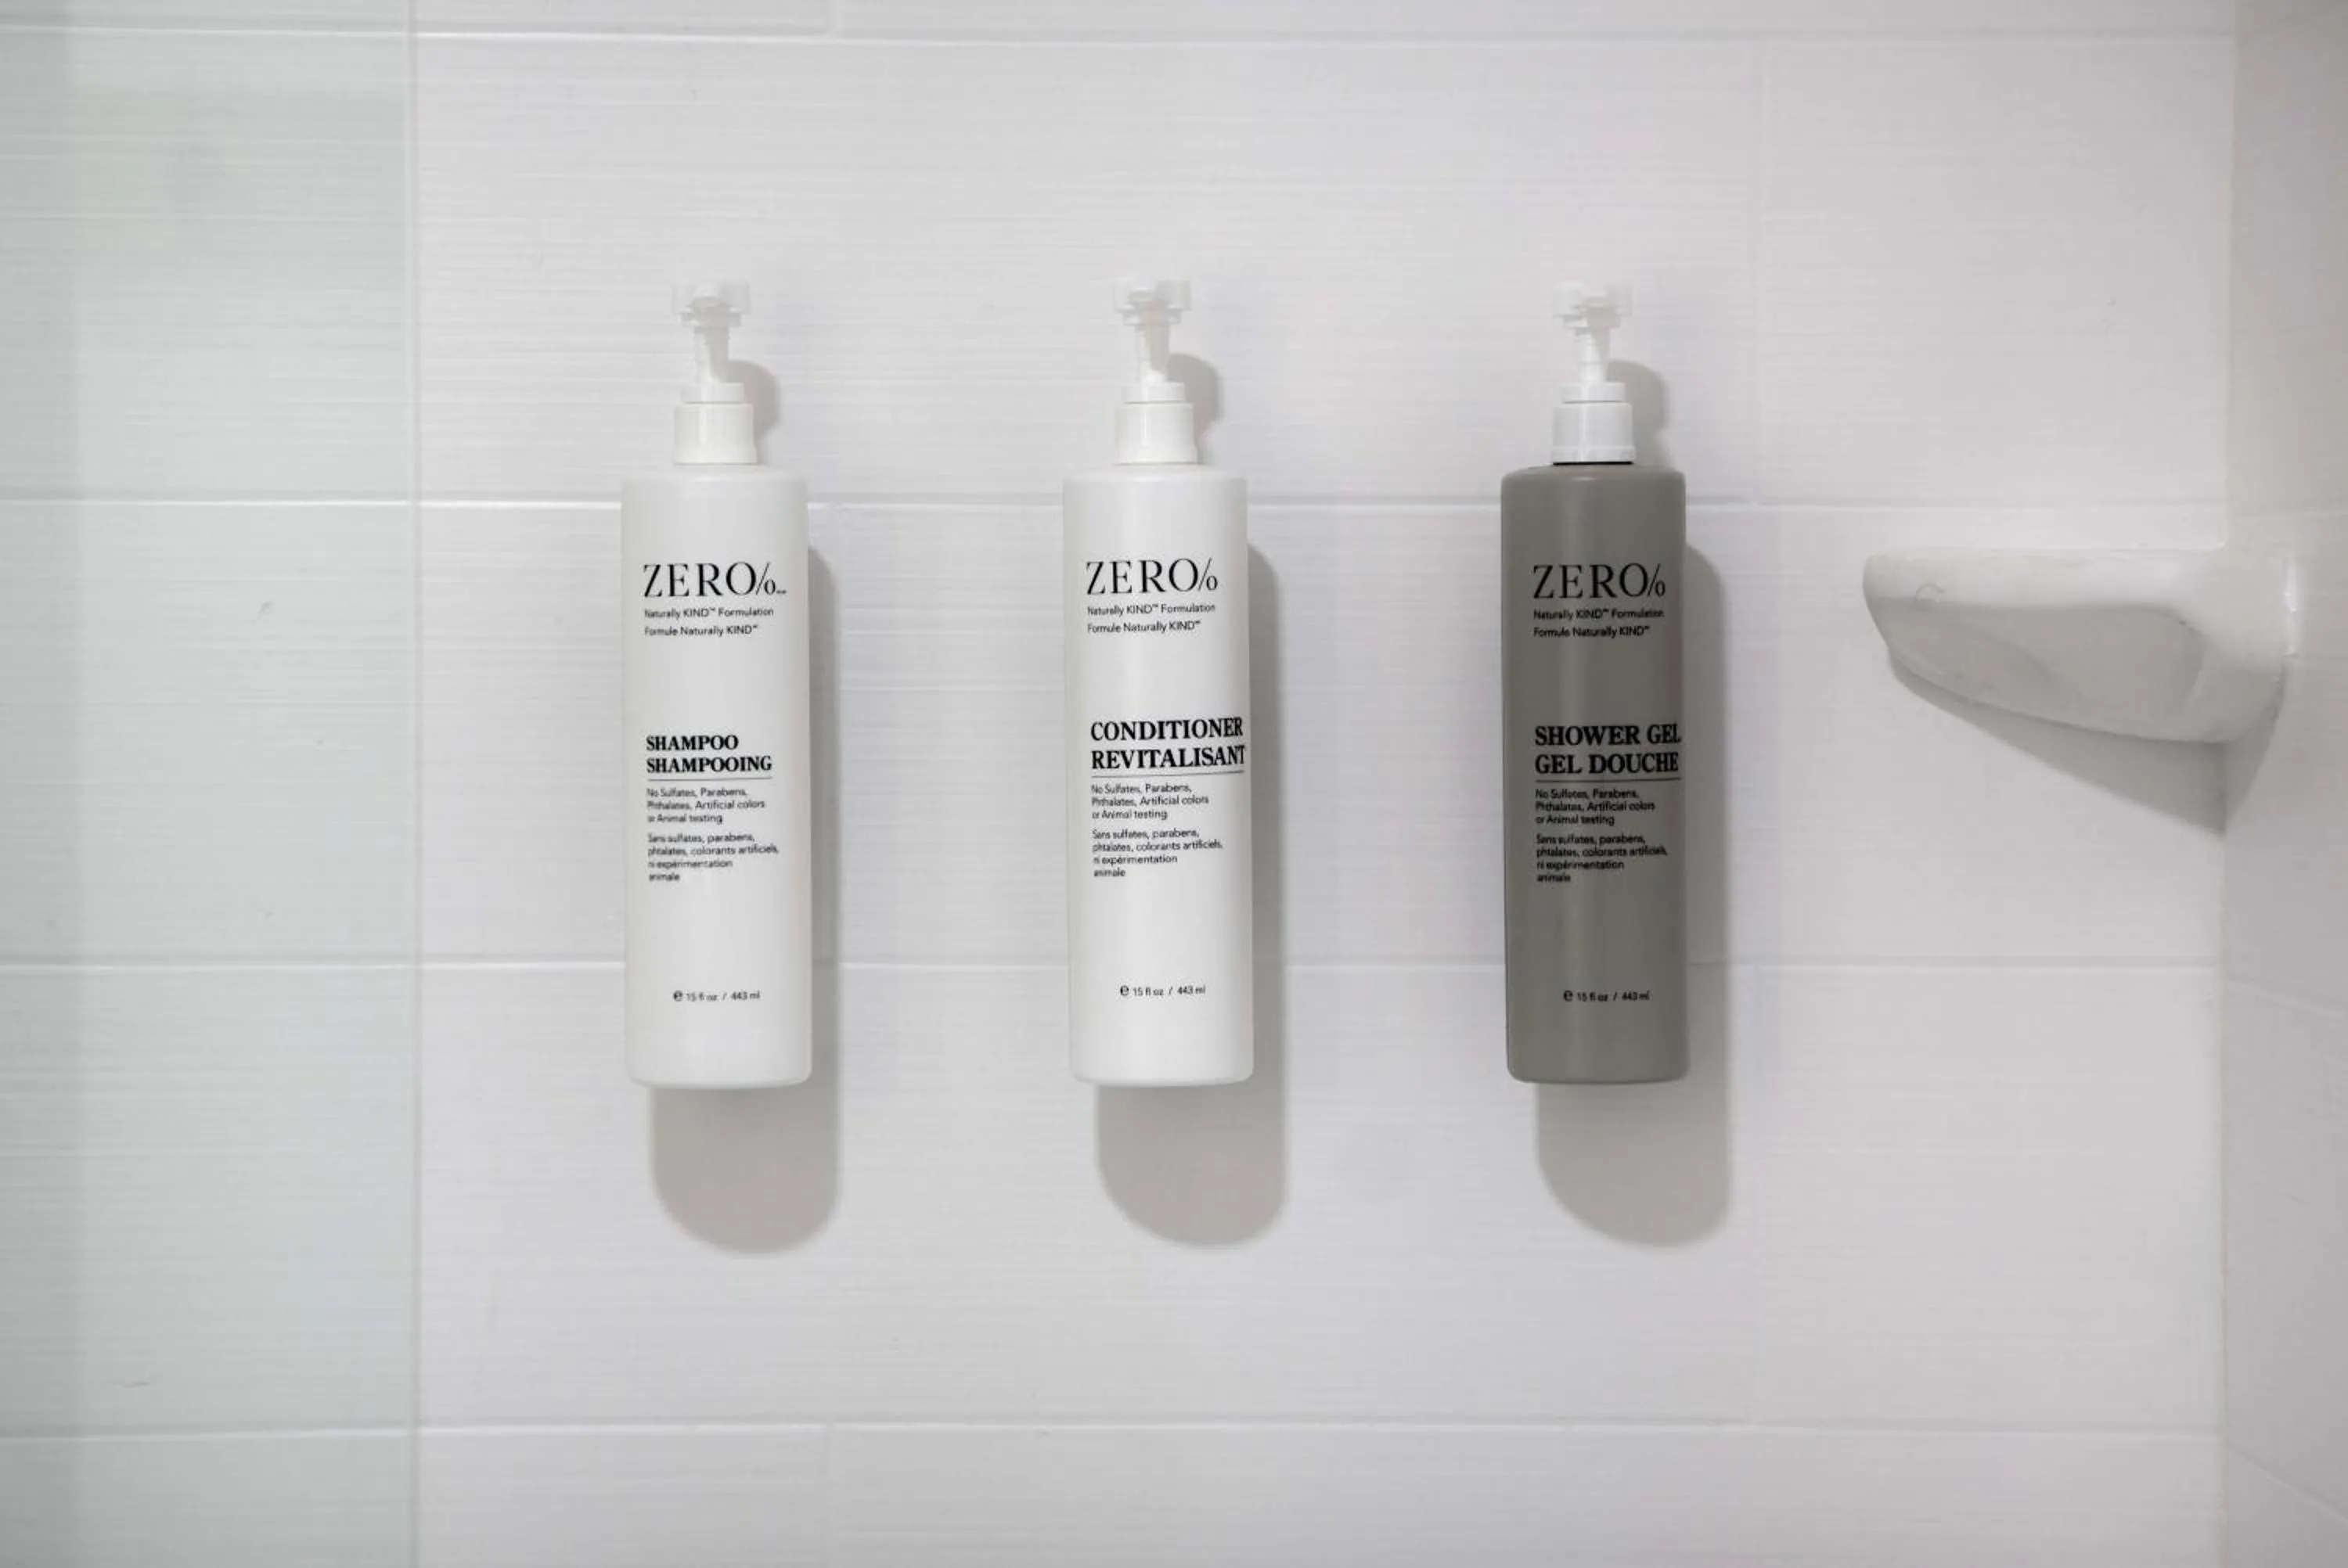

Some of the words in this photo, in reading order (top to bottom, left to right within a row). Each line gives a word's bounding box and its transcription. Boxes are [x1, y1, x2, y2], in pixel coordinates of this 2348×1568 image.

[1086, 558, 1218, 595] ZERO%
[1533, 563, 1666, 599] ZERO%
[644, 609, 680, 620] Naturally
[718, 607, 773, 617] Formulation
[1087, 606, 1124, 617] Naturally
[1161, 603, 1215, 613] Formulation
[1533, 610, 1573, 620] Naturally
[1612, 608, 1665, 617] Formulation
[644, 626, 677, 636] Formule
[680, 626, 723, 637] Naturally
[1087, 624, 1121, 633] Formule
[1124, 622, 1167, 634] Naturally
[1533, 628, 1569, 637] Formule
[1572, 626, 1616, 638] Naturally
[1091, 717, 1244, 741] CONDITIONER
[1535, 725, 1640, 746] SHOWER
[1647, 723, 1682, 744] GEL
[646, 735, 739, 751] SHAMPOO
[1091, 745, 1245, 769] REVITALISANT
[1536, 753, 1583, 774] GEL
[1588, 751, 1679, 774] DOUCHE
[646, 756, 772, 773] SHAMPOOING
[646, 788, 658, 797] No
[661, 788, 697, 797] Sulfates,
[700, 787, 748, 797] Parabens,
[1105, 784, 1142, 794] Sulfates,
[1145, 783, 1191, 793] Parabens,
[1140, 795, 1179, 805] Artificial
[1182, 795, 1209, 804] colors
[1536, 789, 1548, 798] No
[1550, 789, 1589, 800] Sulfates,
[1593, 789, 1639, 798] Parabens,
[695, 800, 734, 809] Artificial
[736, 799, 765, 808] colors
[1587, 801, 1626, 811] Artificial
[1629, 800, 1655, 811] colors
[657, 814, 686, 822] Animal
[689, 814, 723, 825] testing
[1102, 810, 1132, 819] Animal
[1134, 810, 1168, 820] testing
[1547, 815, 1579, 824] Animal
[1581, 815, 1615, 826] testing
[648, 833, 665, 843] Sans
[668, 834, 704, 843] sulfates,
[707, 833, 755, 843] parabens,
[1093, 829, 1111, 839] Sans
[1112, 829, 1150, 840] sulfates,
[1152, 828, 1199, 839] parabens,
[1536, 834, 1556, 843] Sans
[1558, 835, 1597, 844] sulfates,
[1600, 833, 1645, 844] parabens,
[691, 846, 736, 855] colorants
[1136, 841, 1181, 851] colorants
[1583, 846, 1627, 857] colorants
[649, 872, 680, 881] animale
[1093, 867, 1125, 877] animale
[1133, 987, 1143, 996] 15
[1177, 985, 1193, 995] 443
[1196, 984, 1206, 994] ml
[686, 992, 697, 1002] 15
[731, 991, 747, 1000] 443
[750, 991, 761, 1000] ml
[1578, 992, 1587, 1002] 15
[1622, 991, 1637, 1001] 443
